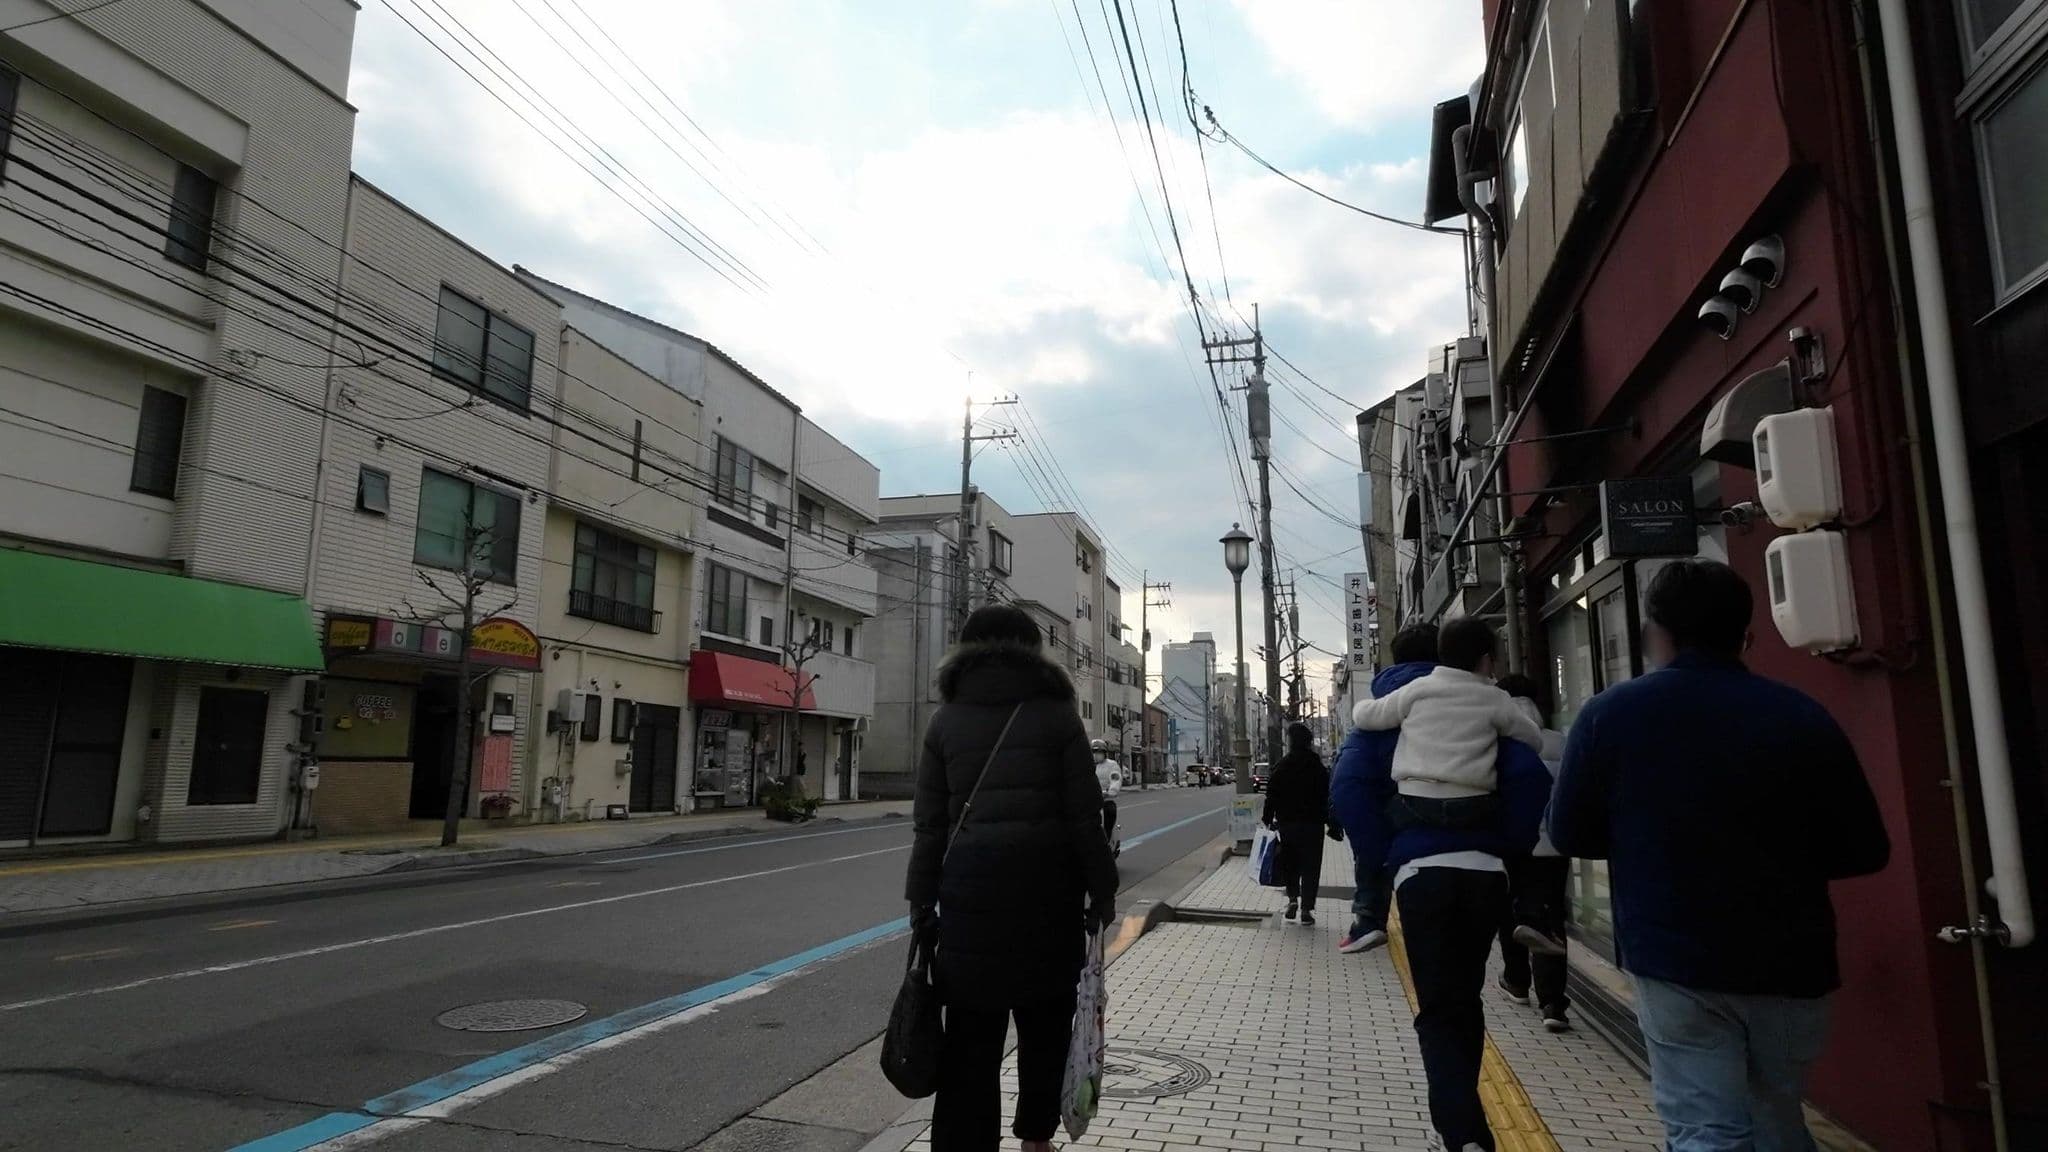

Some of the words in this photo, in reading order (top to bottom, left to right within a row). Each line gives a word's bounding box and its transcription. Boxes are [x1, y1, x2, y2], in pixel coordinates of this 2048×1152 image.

[1618, 500, 1684, 514] SALON
[1351, 577, 1364, 665] 井上歯科医院
